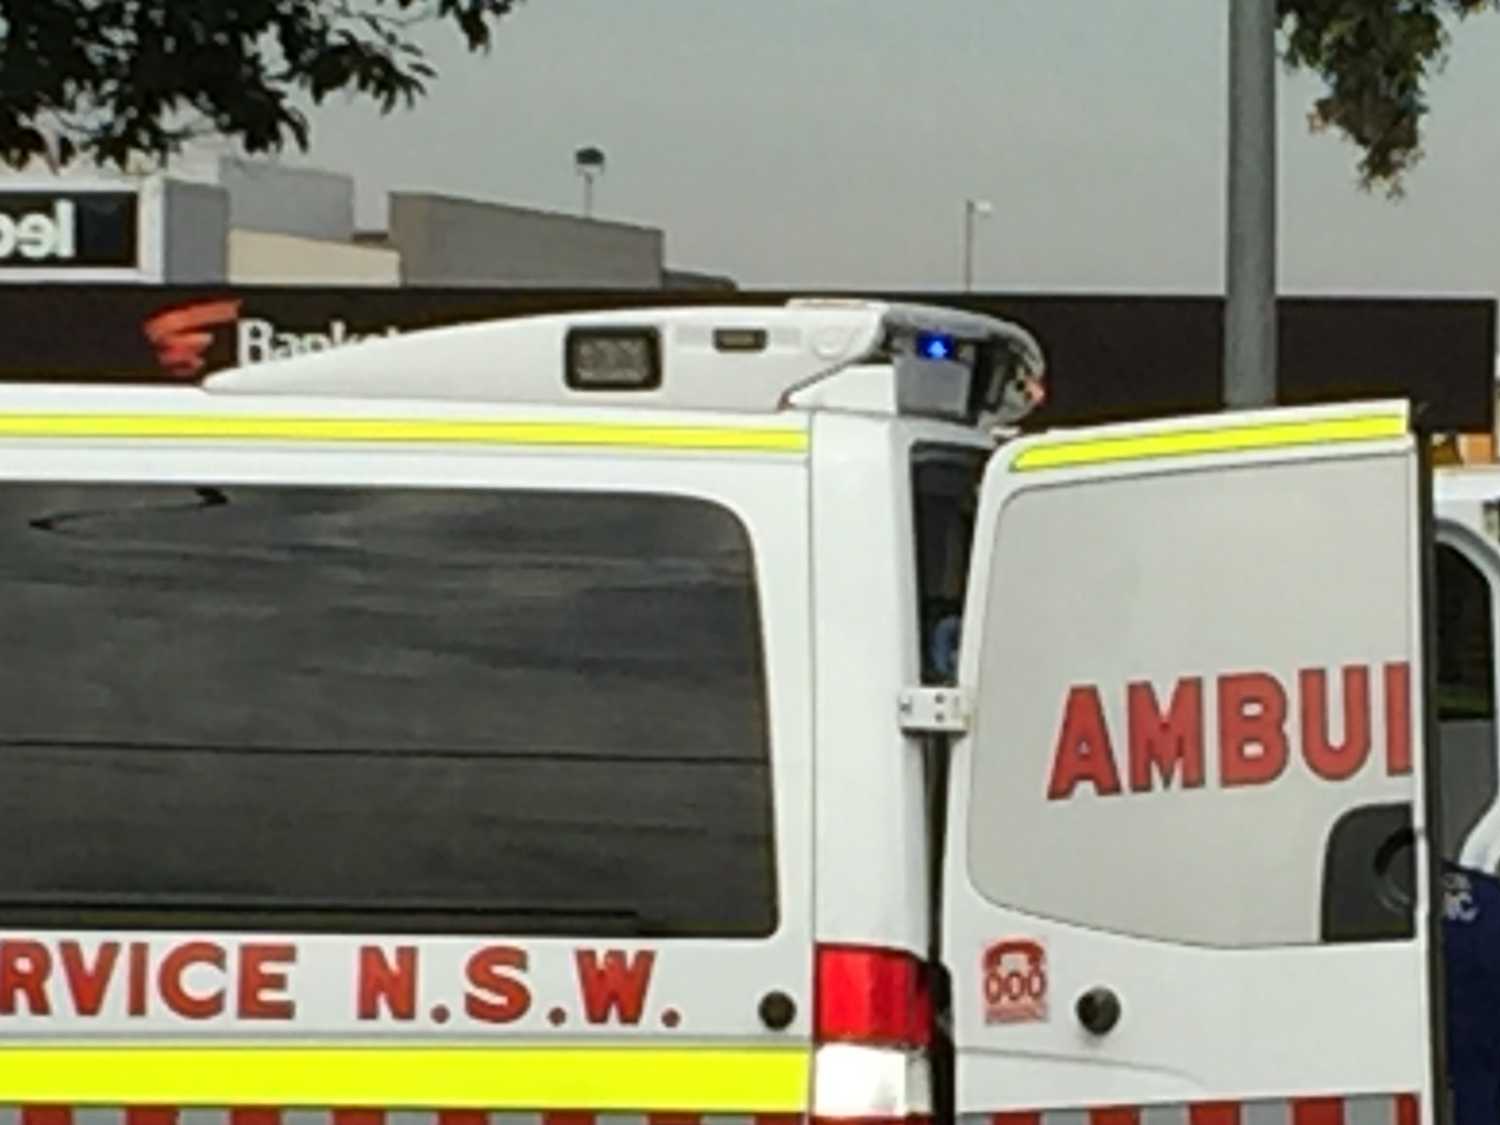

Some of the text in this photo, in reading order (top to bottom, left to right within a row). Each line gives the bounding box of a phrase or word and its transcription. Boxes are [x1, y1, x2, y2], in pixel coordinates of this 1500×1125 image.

[0, 939, 680, 1028] RVICE N.S.W.
[984, 971, 1047, 1004] 000
